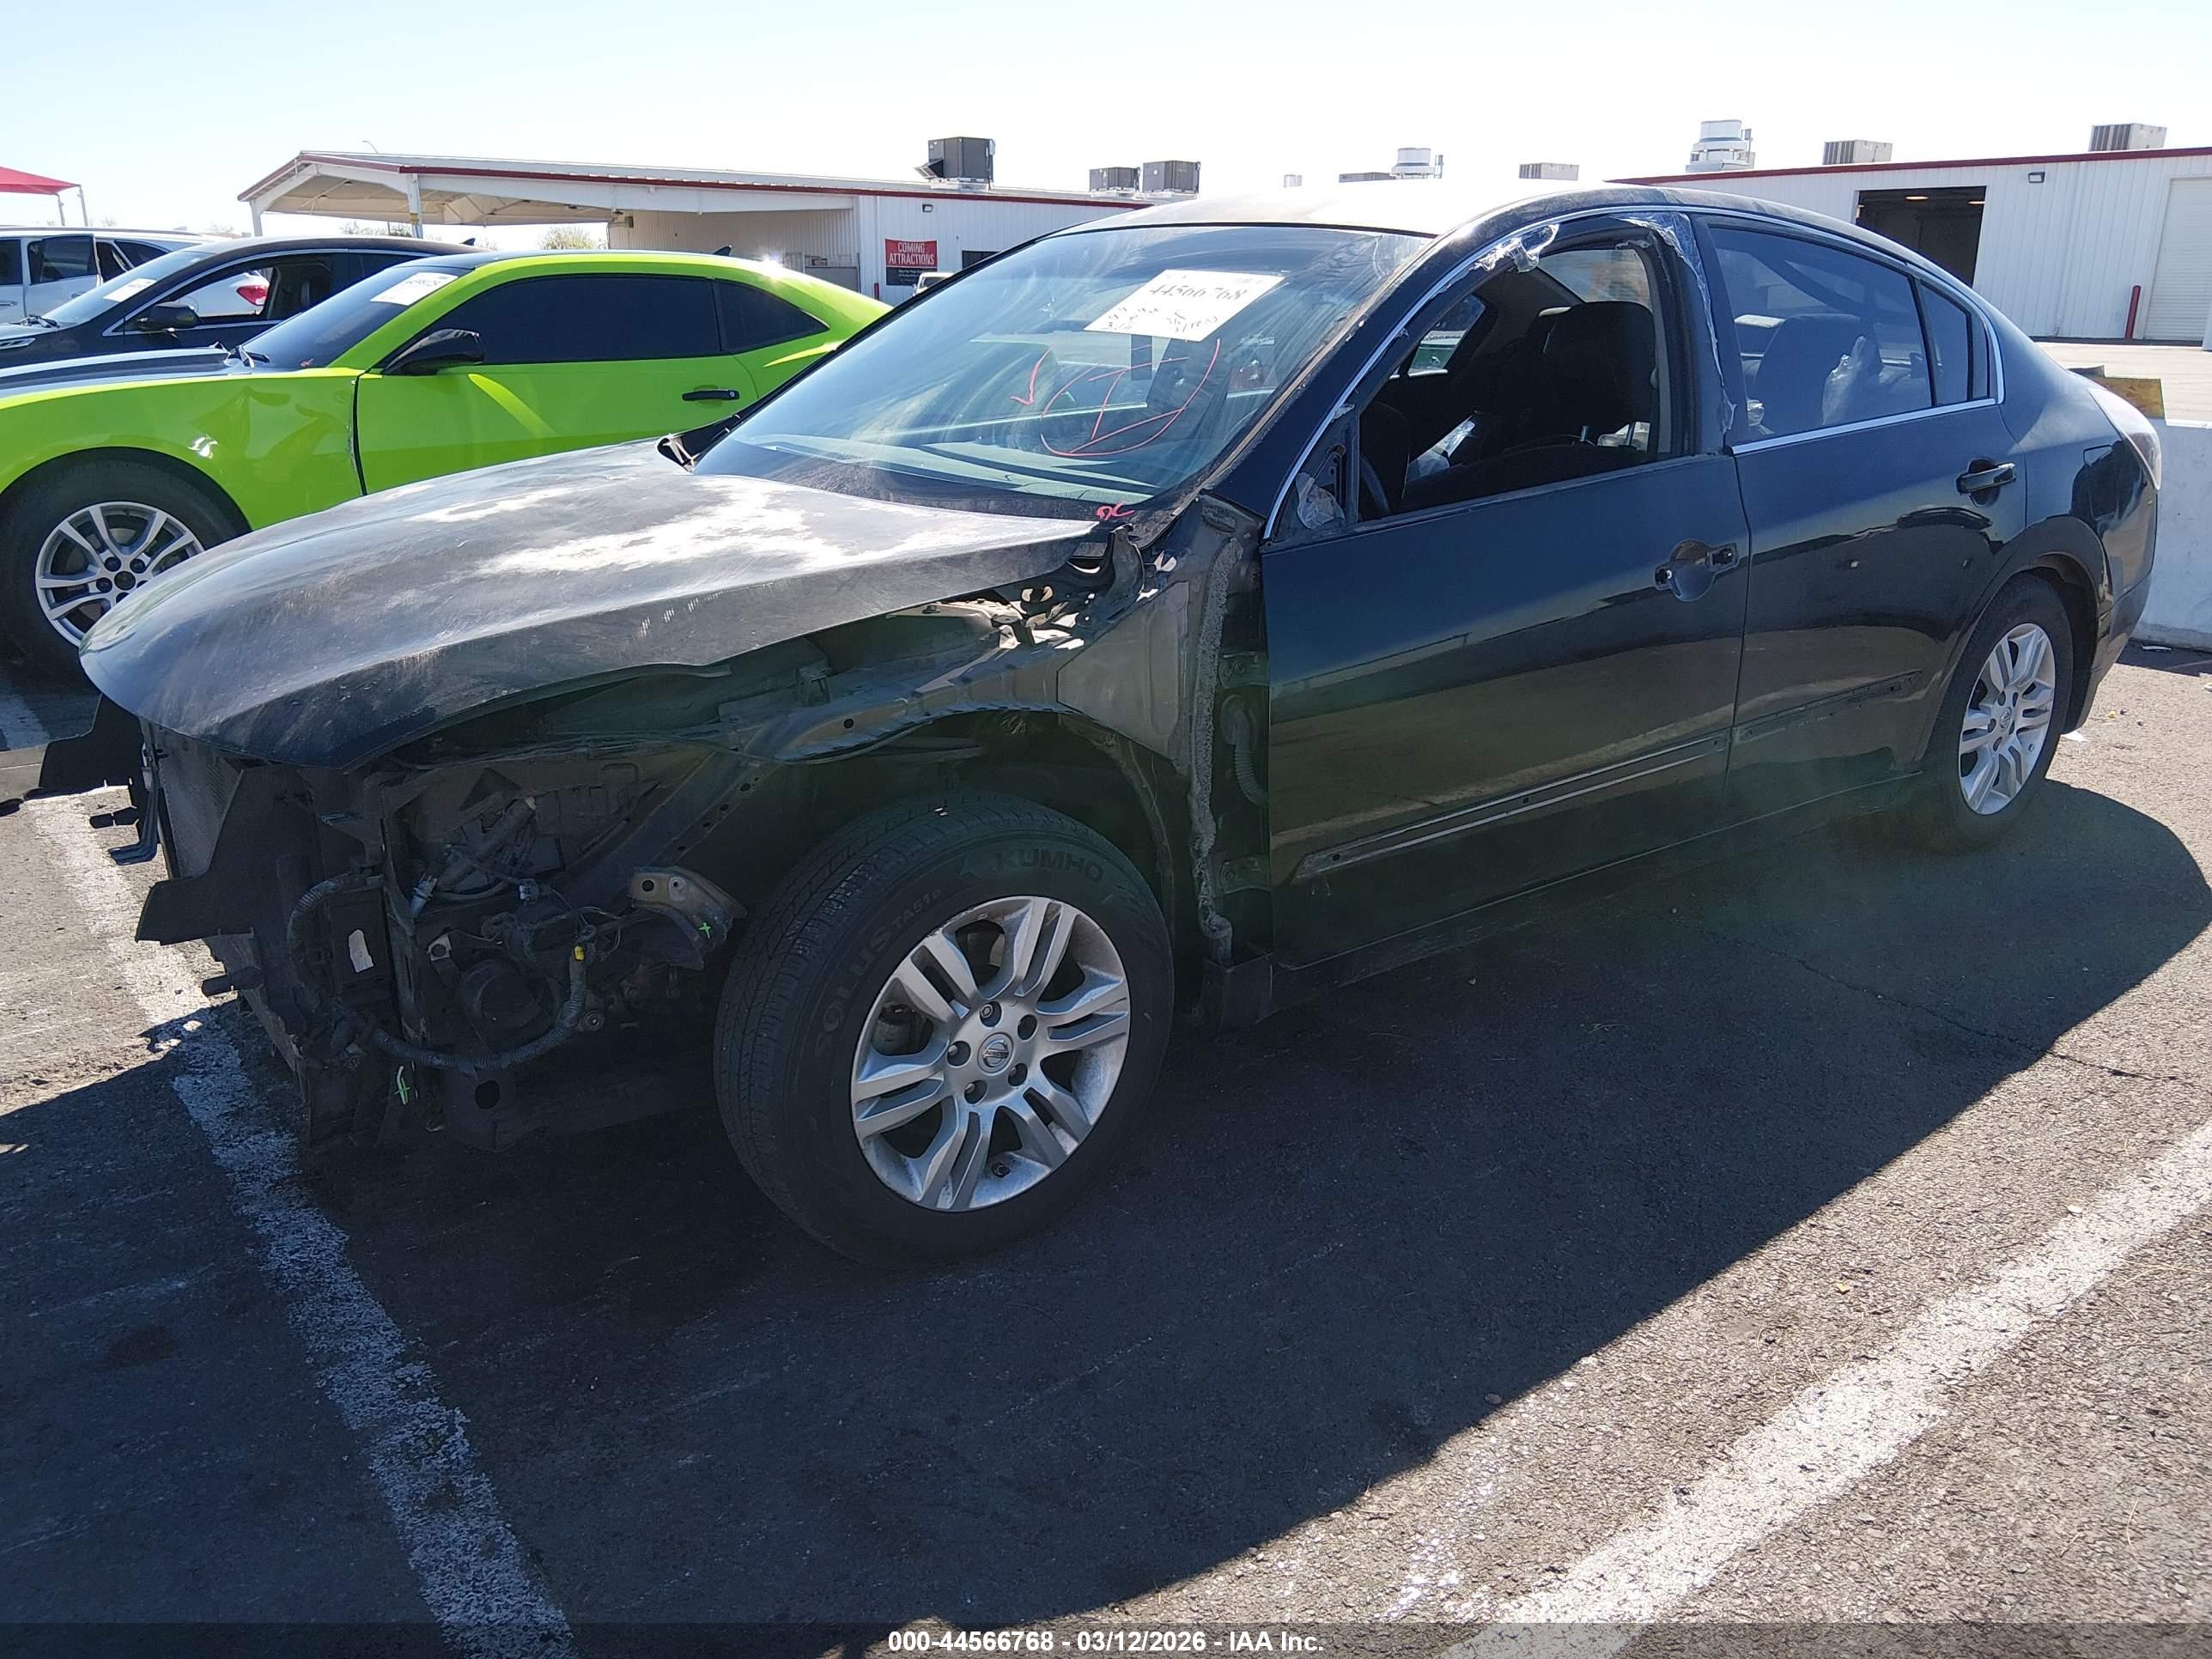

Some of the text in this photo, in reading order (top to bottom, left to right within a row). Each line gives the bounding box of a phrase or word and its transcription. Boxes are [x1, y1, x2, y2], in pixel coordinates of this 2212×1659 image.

[888, 252, 935, 265] ATTRACTIONS
[897, 241, 925, 253] COMING
[994, 848, 1104, 883] KUMHO
[815, 927, 891, 1059] SOLUS
